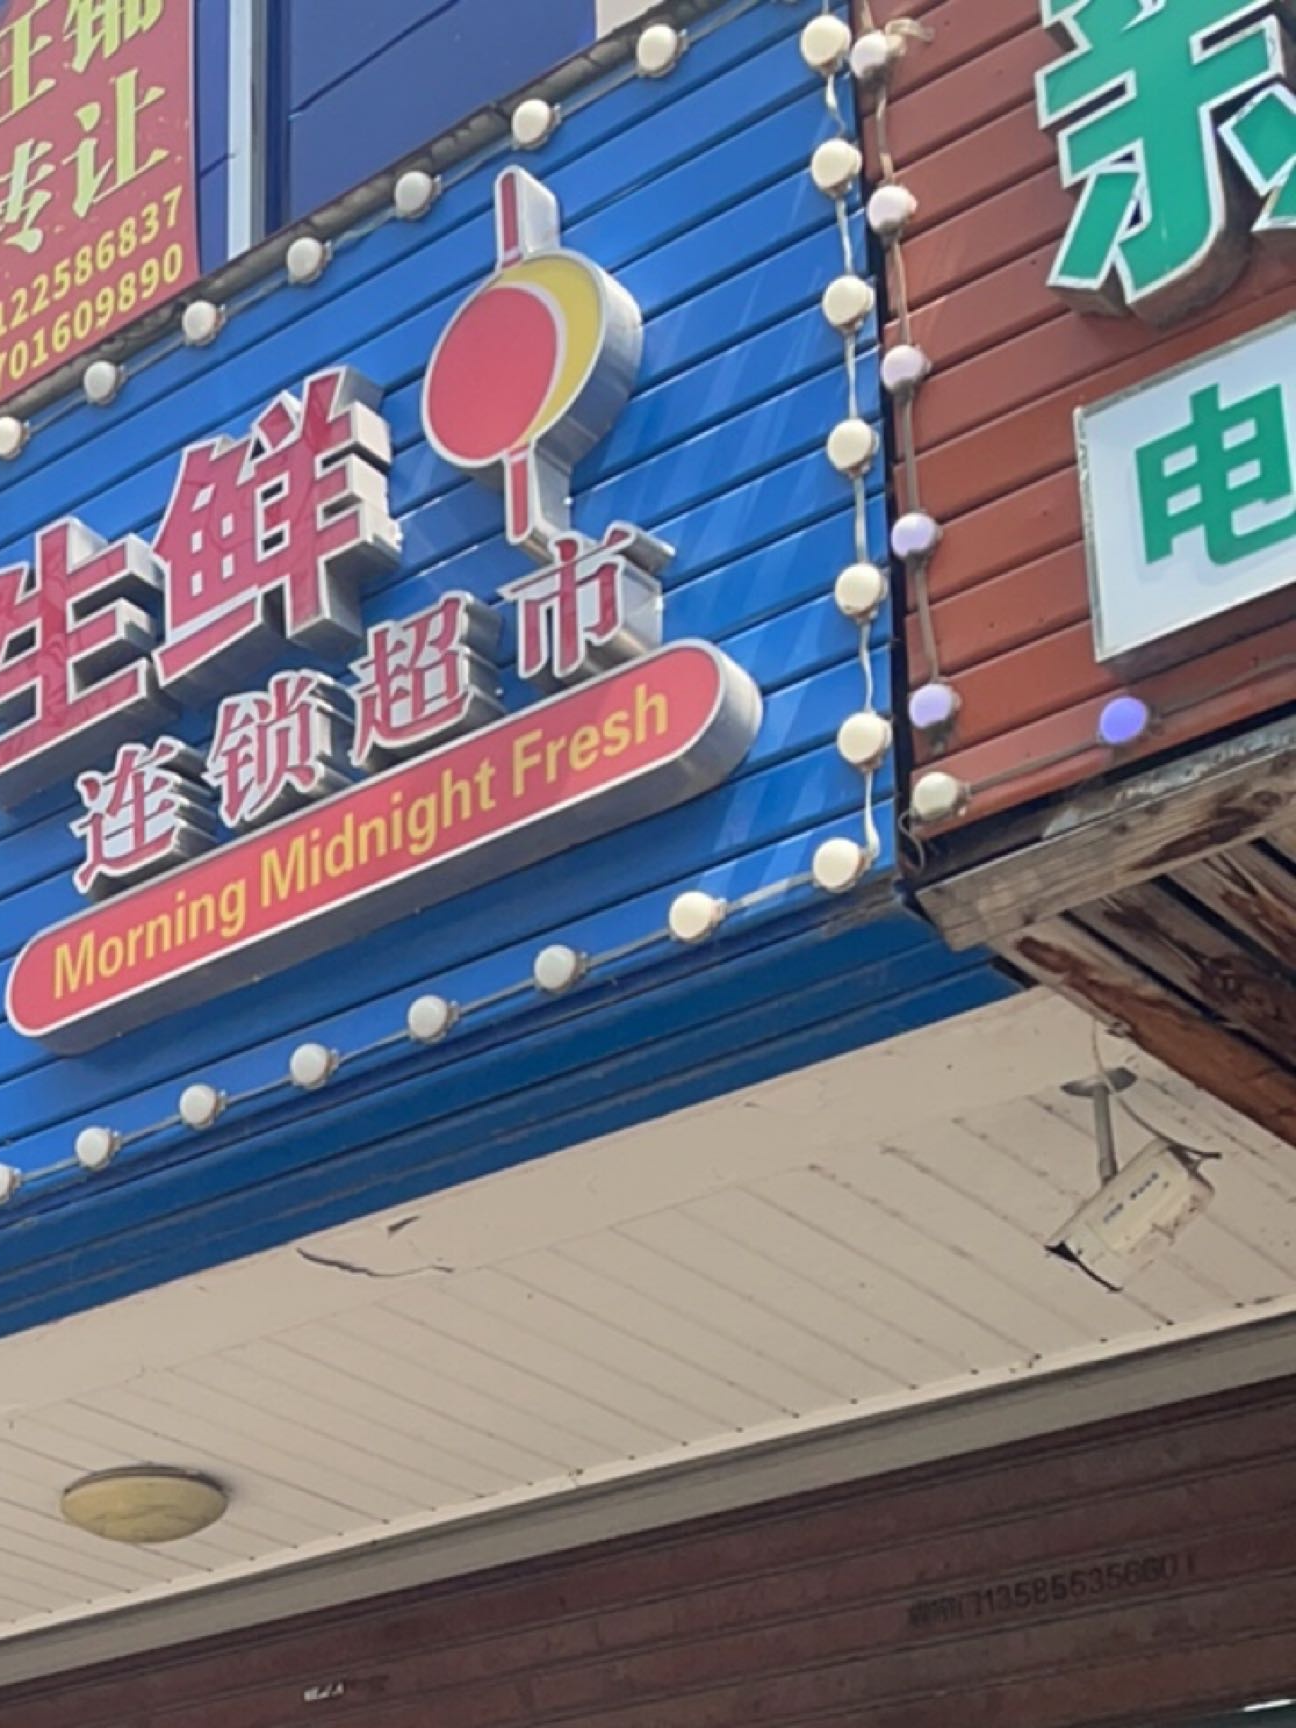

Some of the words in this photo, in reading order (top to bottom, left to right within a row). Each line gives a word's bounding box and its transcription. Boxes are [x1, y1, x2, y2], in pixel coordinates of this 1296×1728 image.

[1135, 383, 1296, 566] 电
[51, 872, 247, 999] Morning
[259, 758, 498, 911] Midnight
[511, 684, 670, 797] Fresh
[70, 521, 654, 894] 连锁超市
